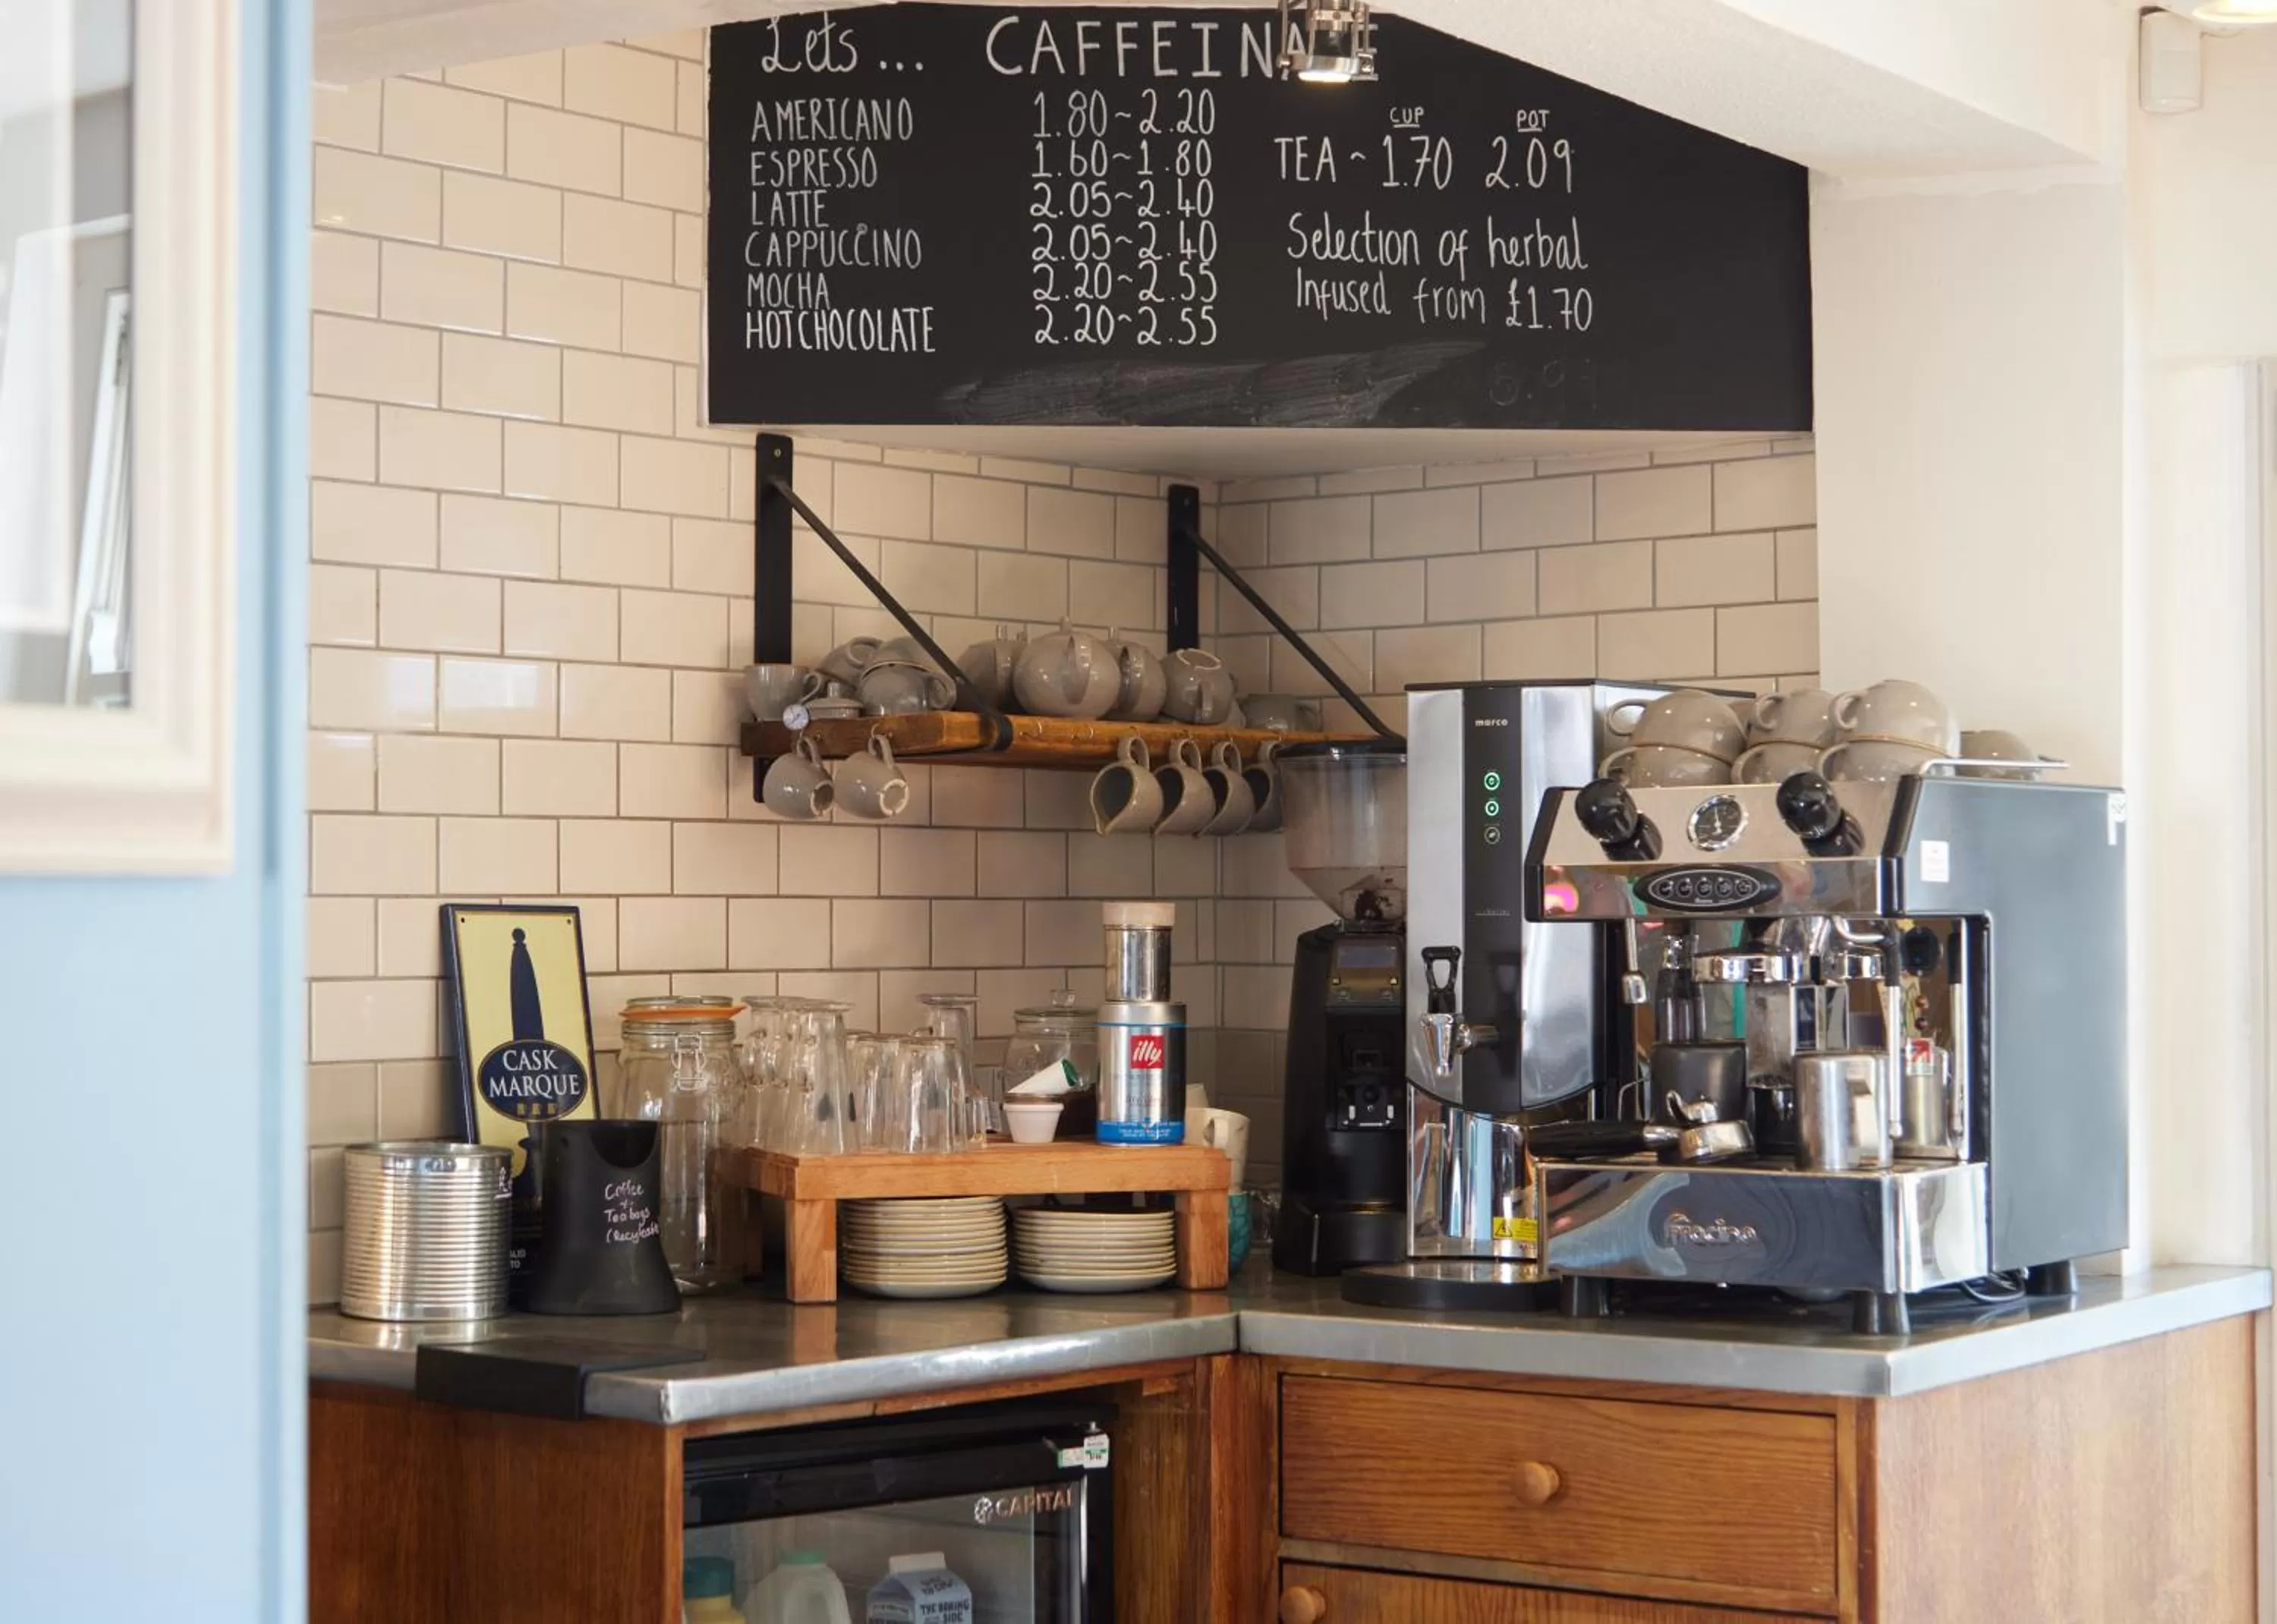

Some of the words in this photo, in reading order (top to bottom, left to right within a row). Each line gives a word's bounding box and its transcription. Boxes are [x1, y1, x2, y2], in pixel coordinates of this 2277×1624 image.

[761, 13, 858, 73] Lets
[986, 15, 1379, 80] CAFFEINAE
[751, 98, 913, 142] AMERICANO
[1390, 106, 1424, 124] CUP
[1516, 109, 1550, 127] POT
[751, 146, 877, 188] ESPRESSO
[1274, 136, 1337, 183] TEA
[1382, 134, 1452, 190] 1.70
[1485, 136, 1571, 193] 2.09
[752, 190, 830, 228] LATTE
[745, 228, 921, 269] CAPPUCCINO
[1287, 210, 1420, 266] Selection
[1438, 229, 1469, 282] of
[1488, 216, 1589, 270] herbal
[747, 272, 830, 310] MOCHA
[1297, 266, 1391, 321] Infused
[1412, 277, 1485, 324] from
[1505, 278, 1592, 332] £1.70
[502, 1050, 559, 1071] CASK
[1132, 1040, 1163, 1067] illy
[490, 1074, 581, 1100] MARQUE
[605, 1179, 644, 1200] Coffee
